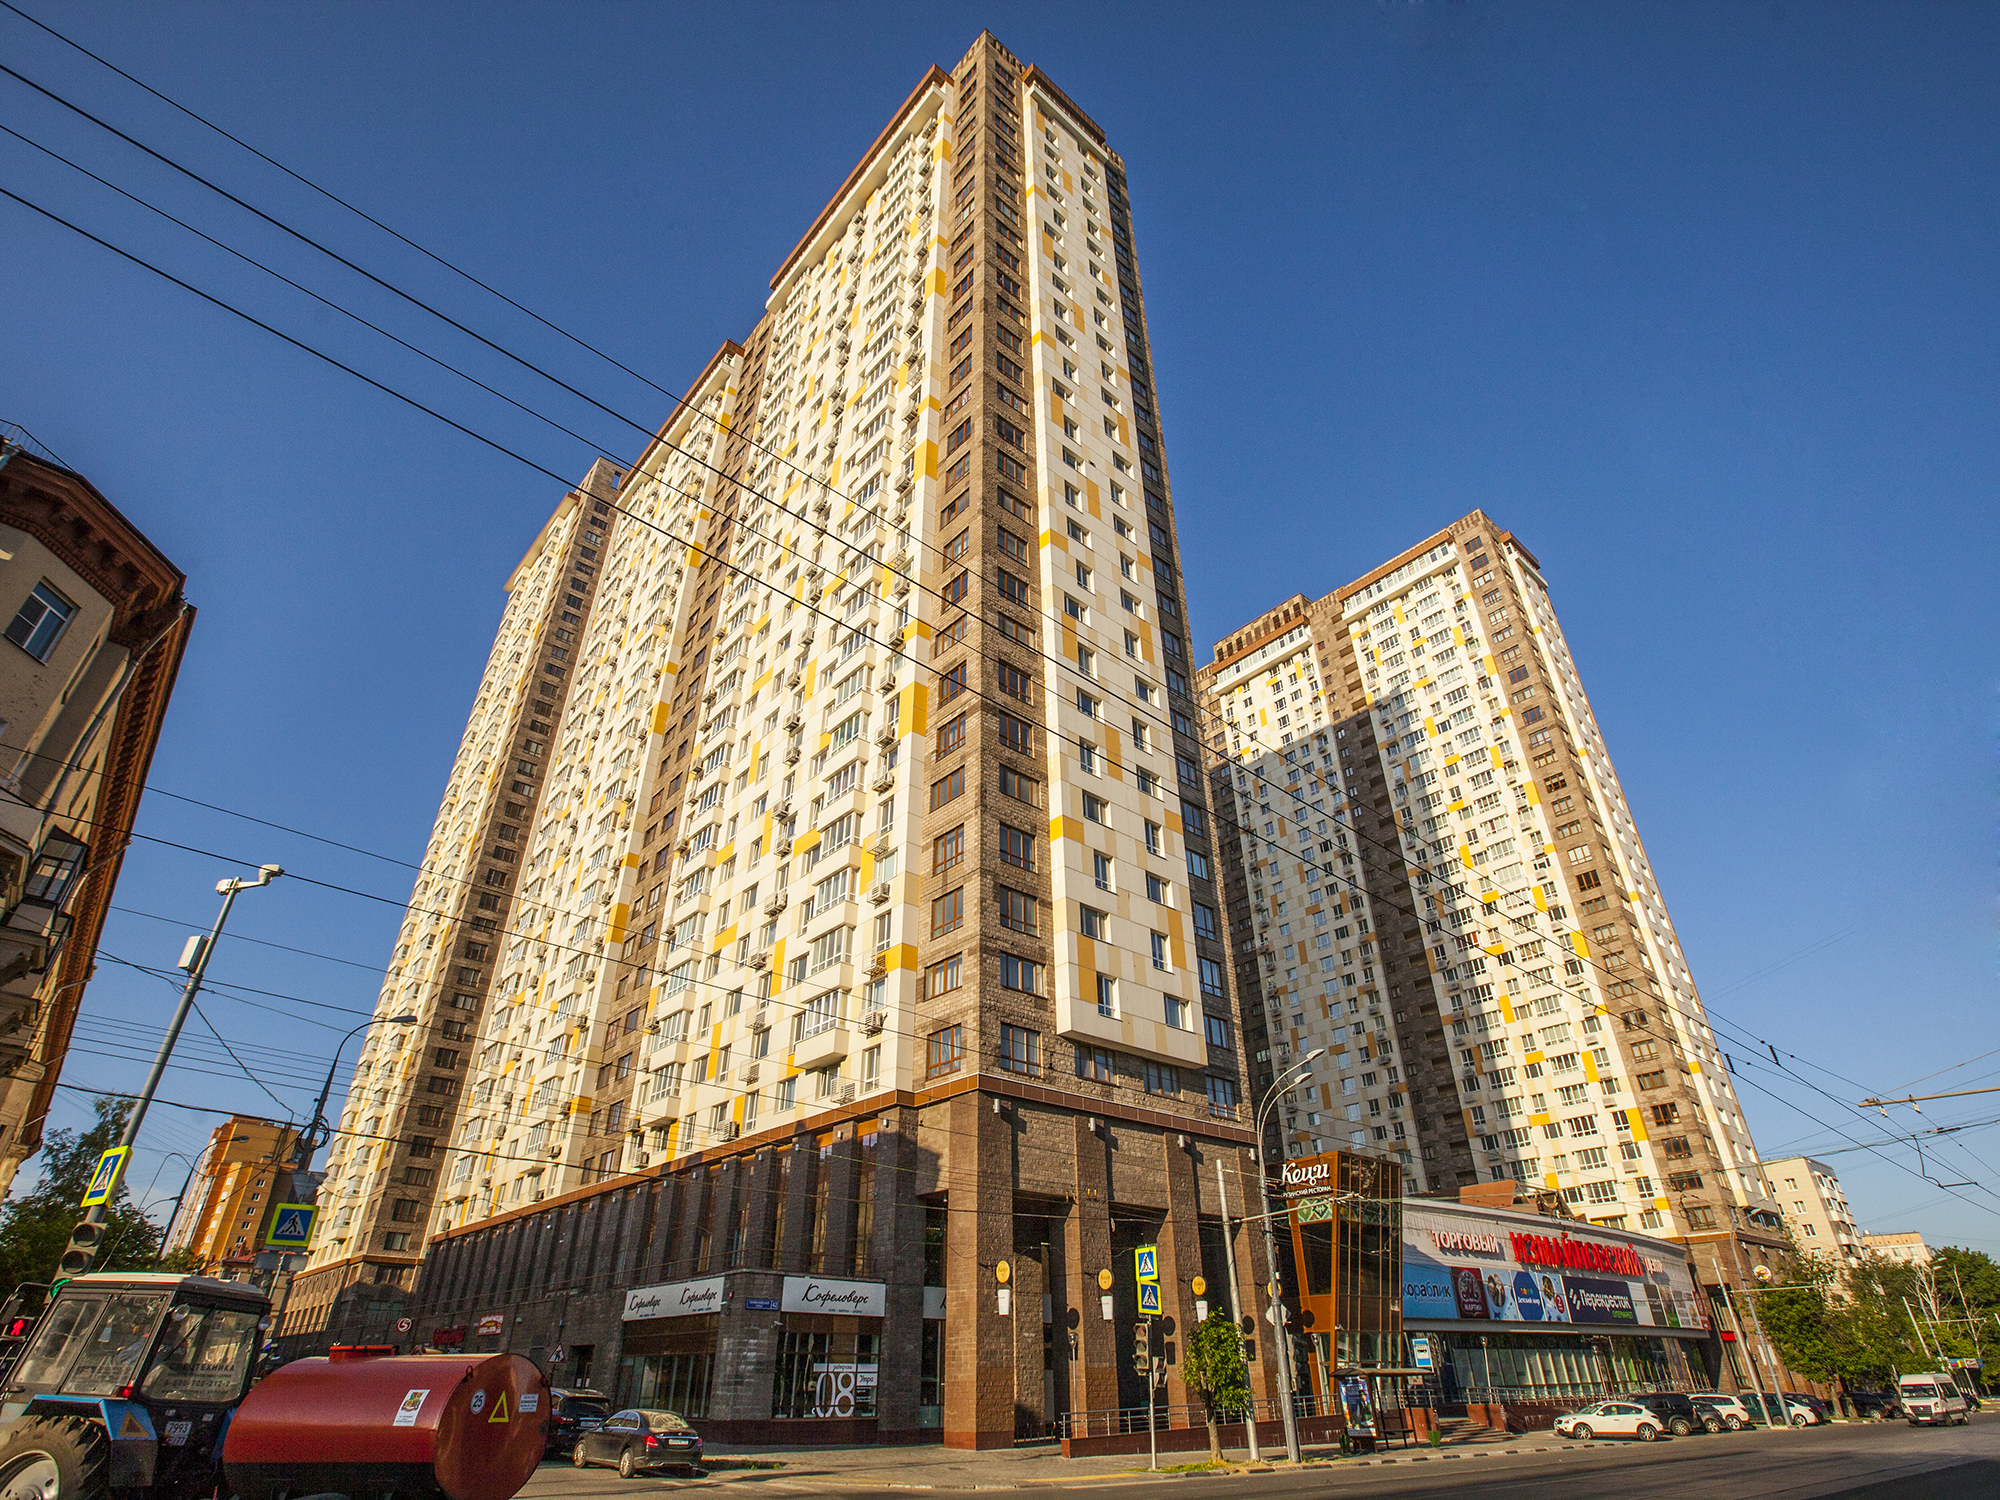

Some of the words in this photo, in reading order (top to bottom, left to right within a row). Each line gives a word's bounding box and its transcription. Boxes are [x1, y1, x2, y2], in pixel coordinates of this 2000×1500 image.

[1280, 1162, 1330, 1186] Кеци
[1430, 1230, 1500, 1254] ТОРГОВЫЙ
[1509, 1231, 1644, 1277] ИЗМАЙЛОВСКИЙ
[679, 1287, 718, 1308] Кофеловерс
[801, 1284, 869, 1308] Кофеловерс
[1403, 1280, 1452, 1300] кораблик
[473, 1394, 483, 1407] 25
[815, 1372, 856, 1418] 08
[167, 1422, 189, 1434] 7993
